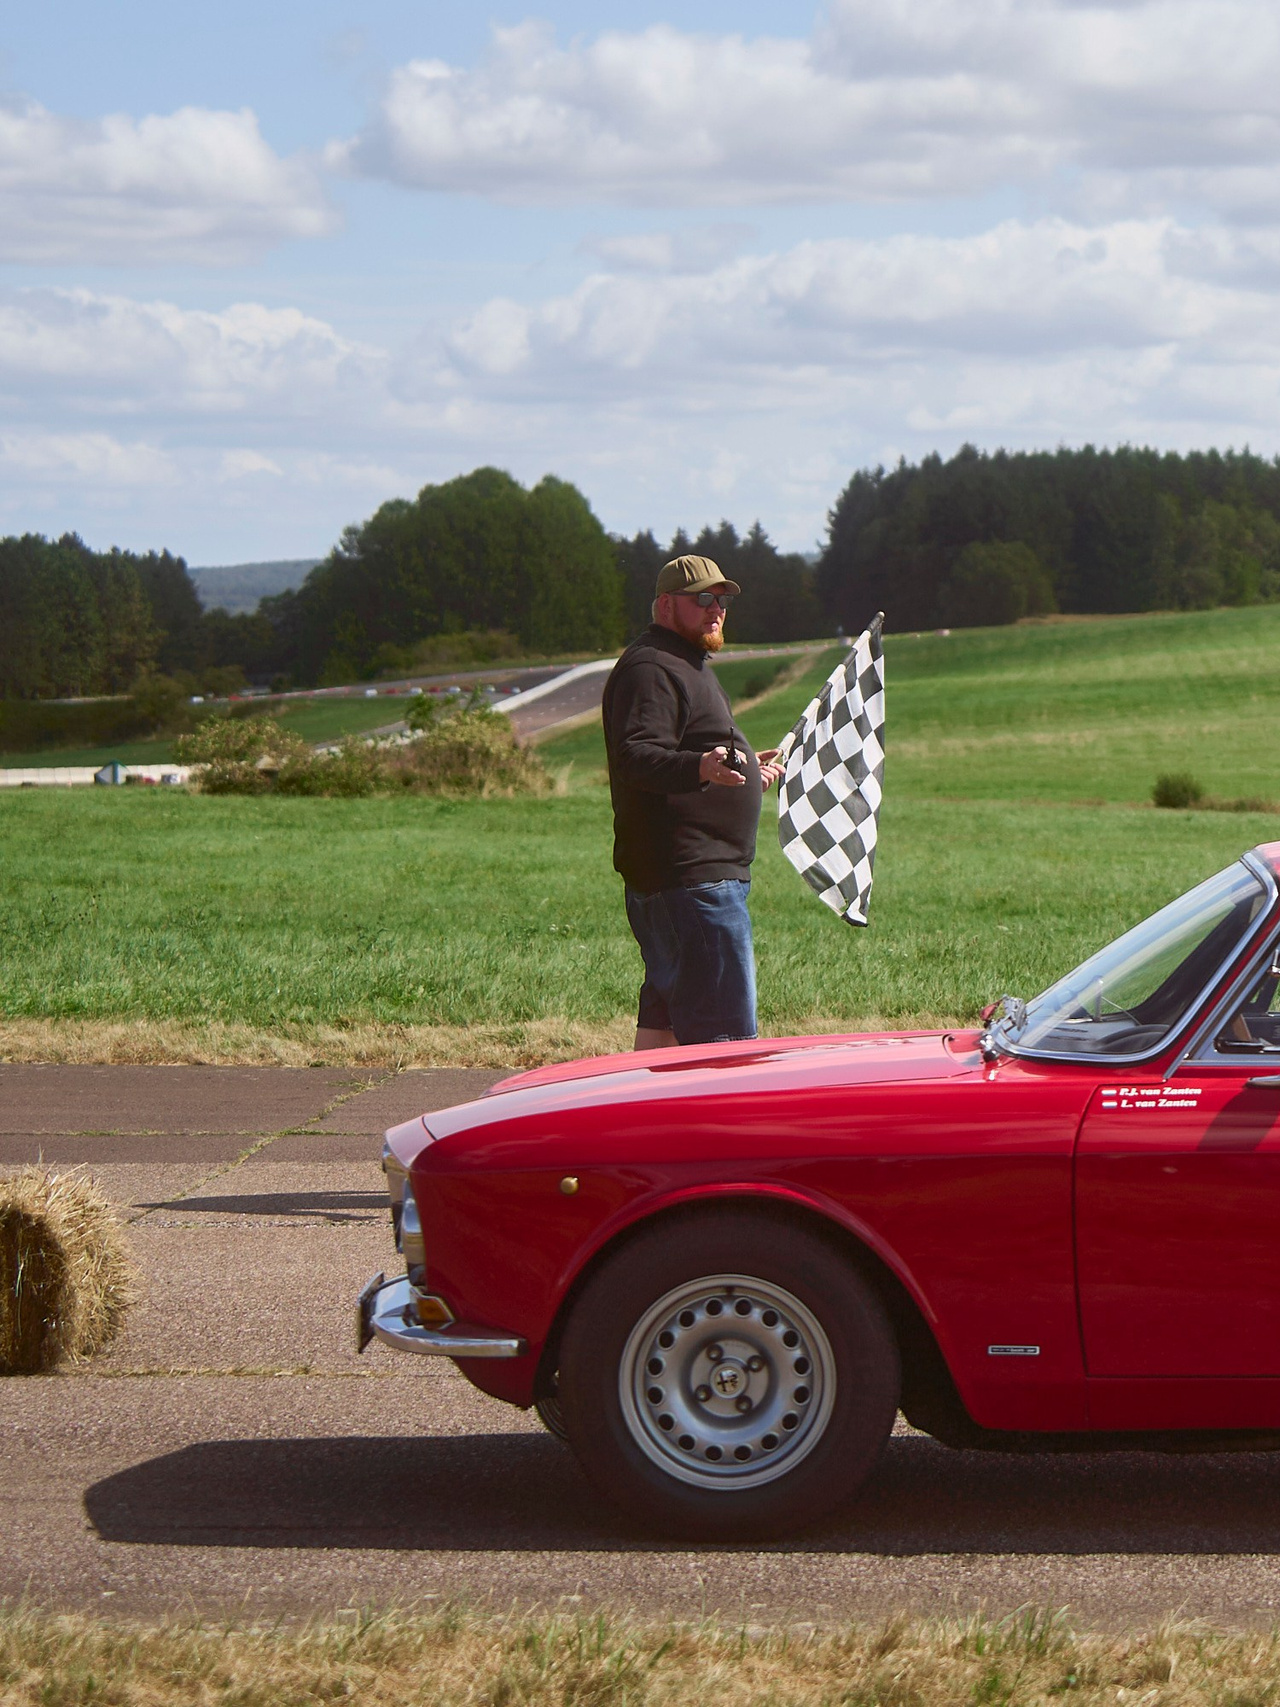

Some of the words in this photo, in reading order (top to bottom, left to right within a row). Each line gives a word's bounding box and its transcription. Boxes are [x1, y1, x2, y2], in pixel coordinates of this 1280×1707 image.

[1140, 1088, 1161, 1096] van
[1163, 1087, 1202, 1095] Zanten
[1135, 1100, 1156, 1108] van
[1157, 1099, 1197, 1107] Zanten
